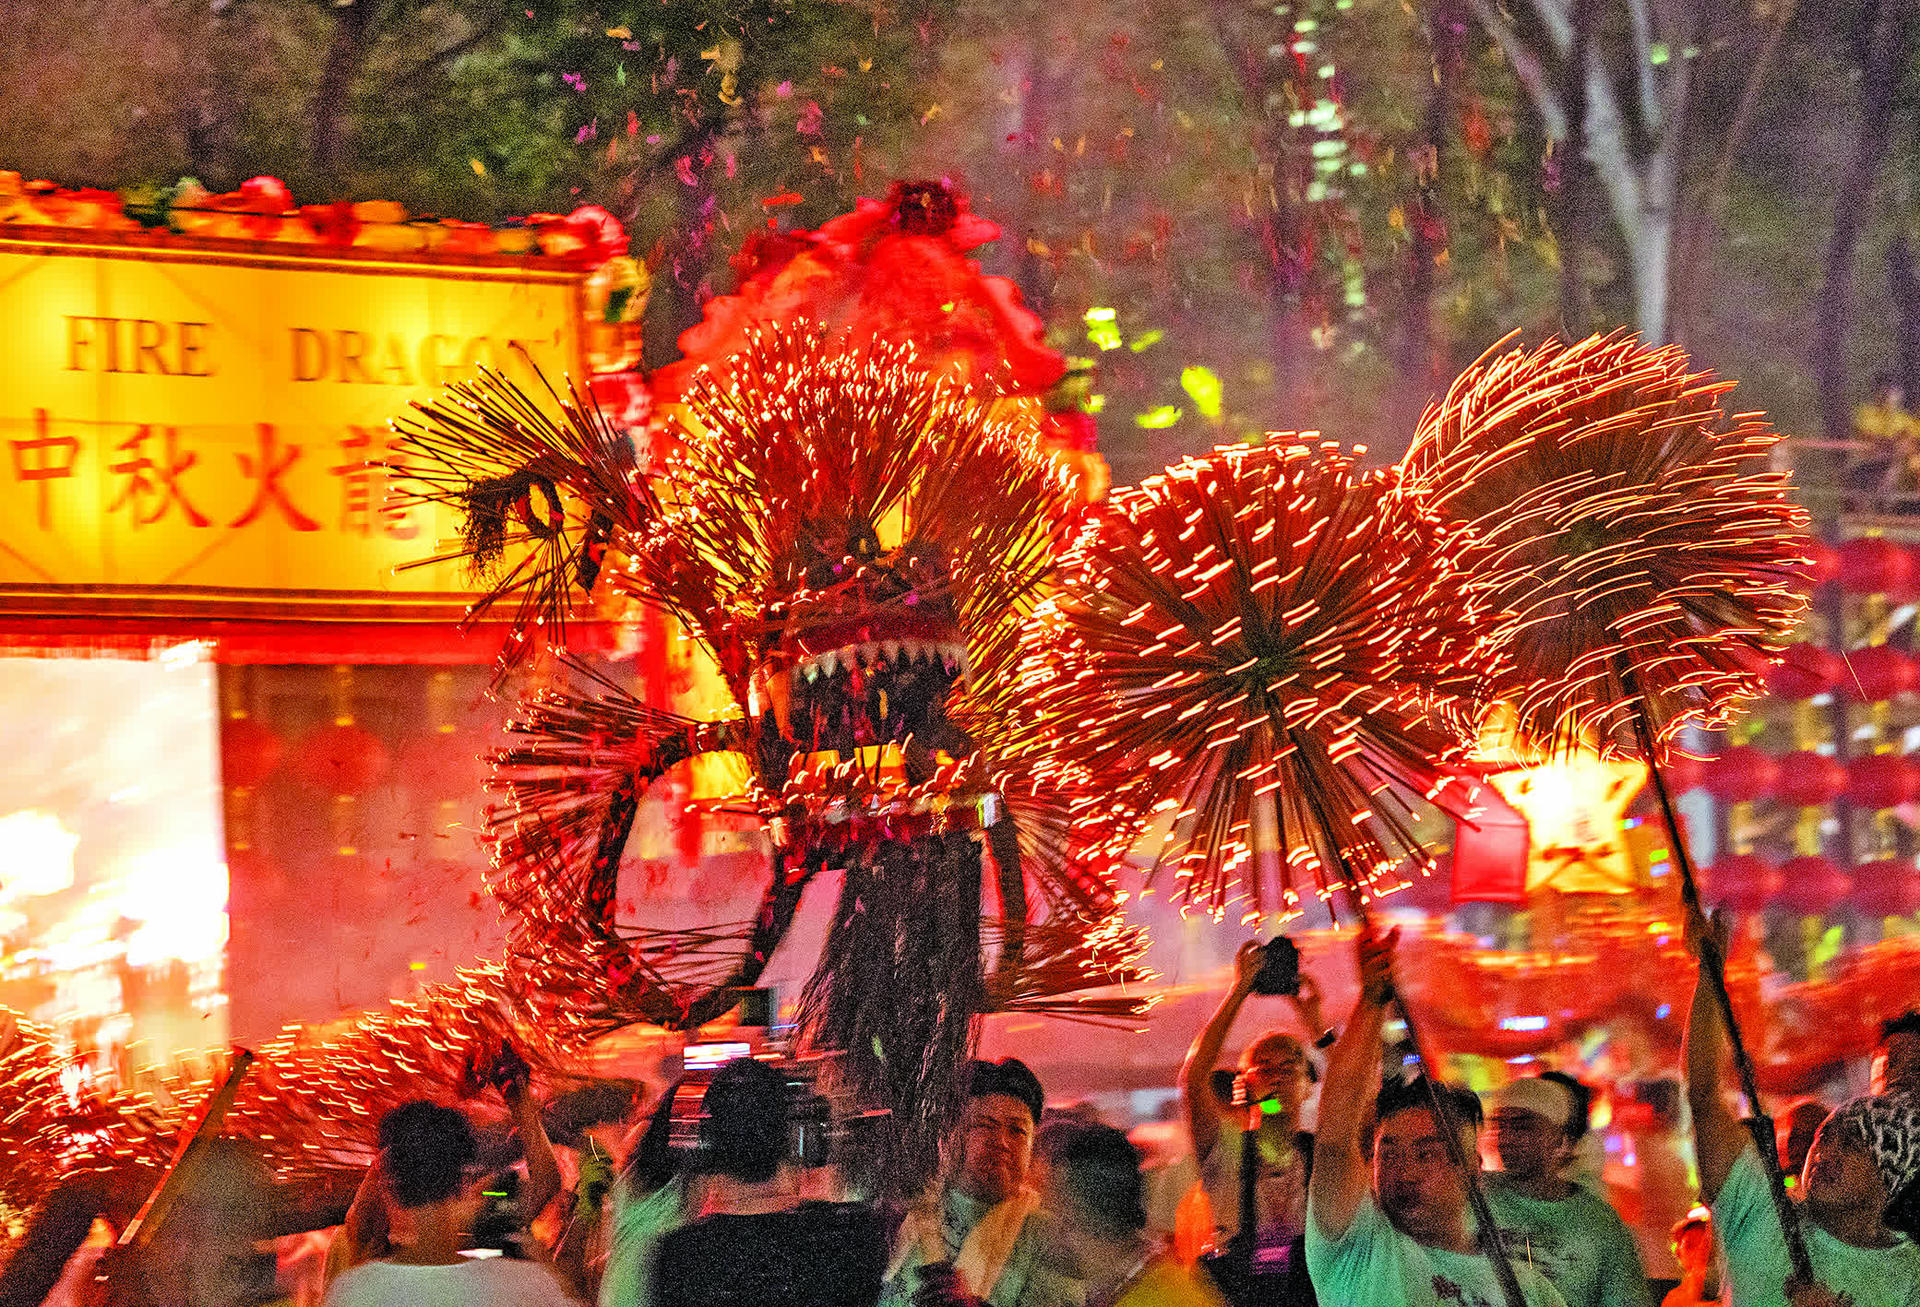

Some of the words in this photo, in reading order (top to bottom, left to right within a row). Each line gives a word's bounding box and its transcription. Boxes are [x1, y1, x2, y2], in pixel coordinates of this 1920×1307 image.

[63, 315, 213, 377] FIRE
[8, 408, 420, 540] 中秋火龍
